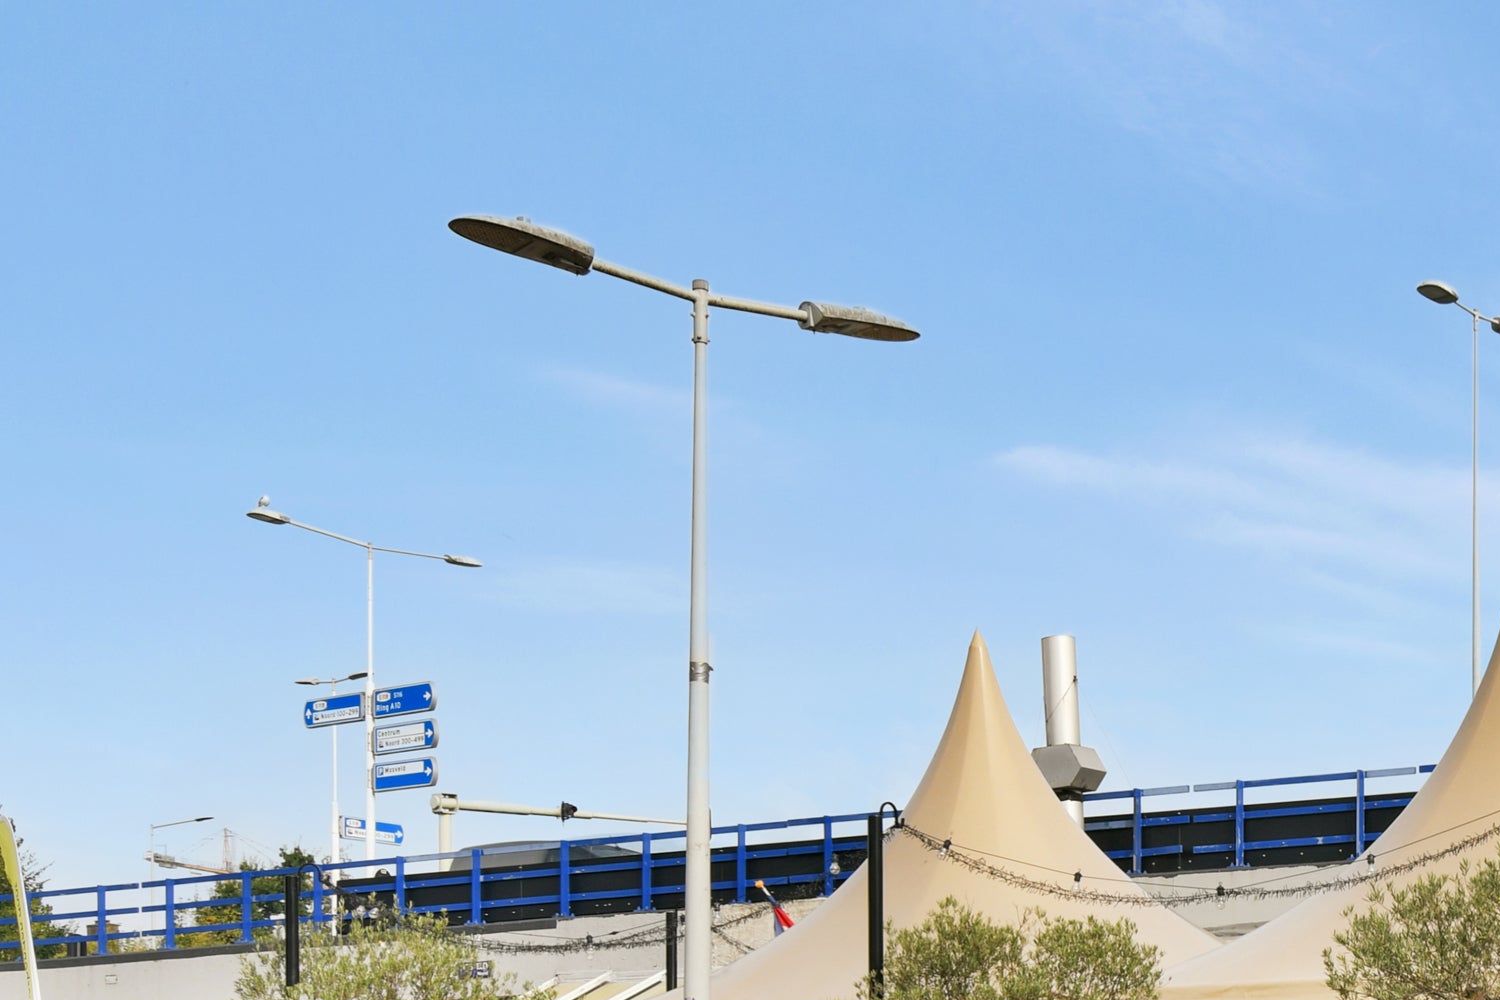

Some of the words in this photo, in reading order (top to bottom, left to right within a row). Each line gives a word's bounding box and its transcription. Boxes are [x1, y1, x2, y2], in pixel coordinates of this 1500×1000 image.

[376, 703, 390, 712] Ring
[390, 701, 401, 710] A10
[378, 729, 400, 738] Centrum
